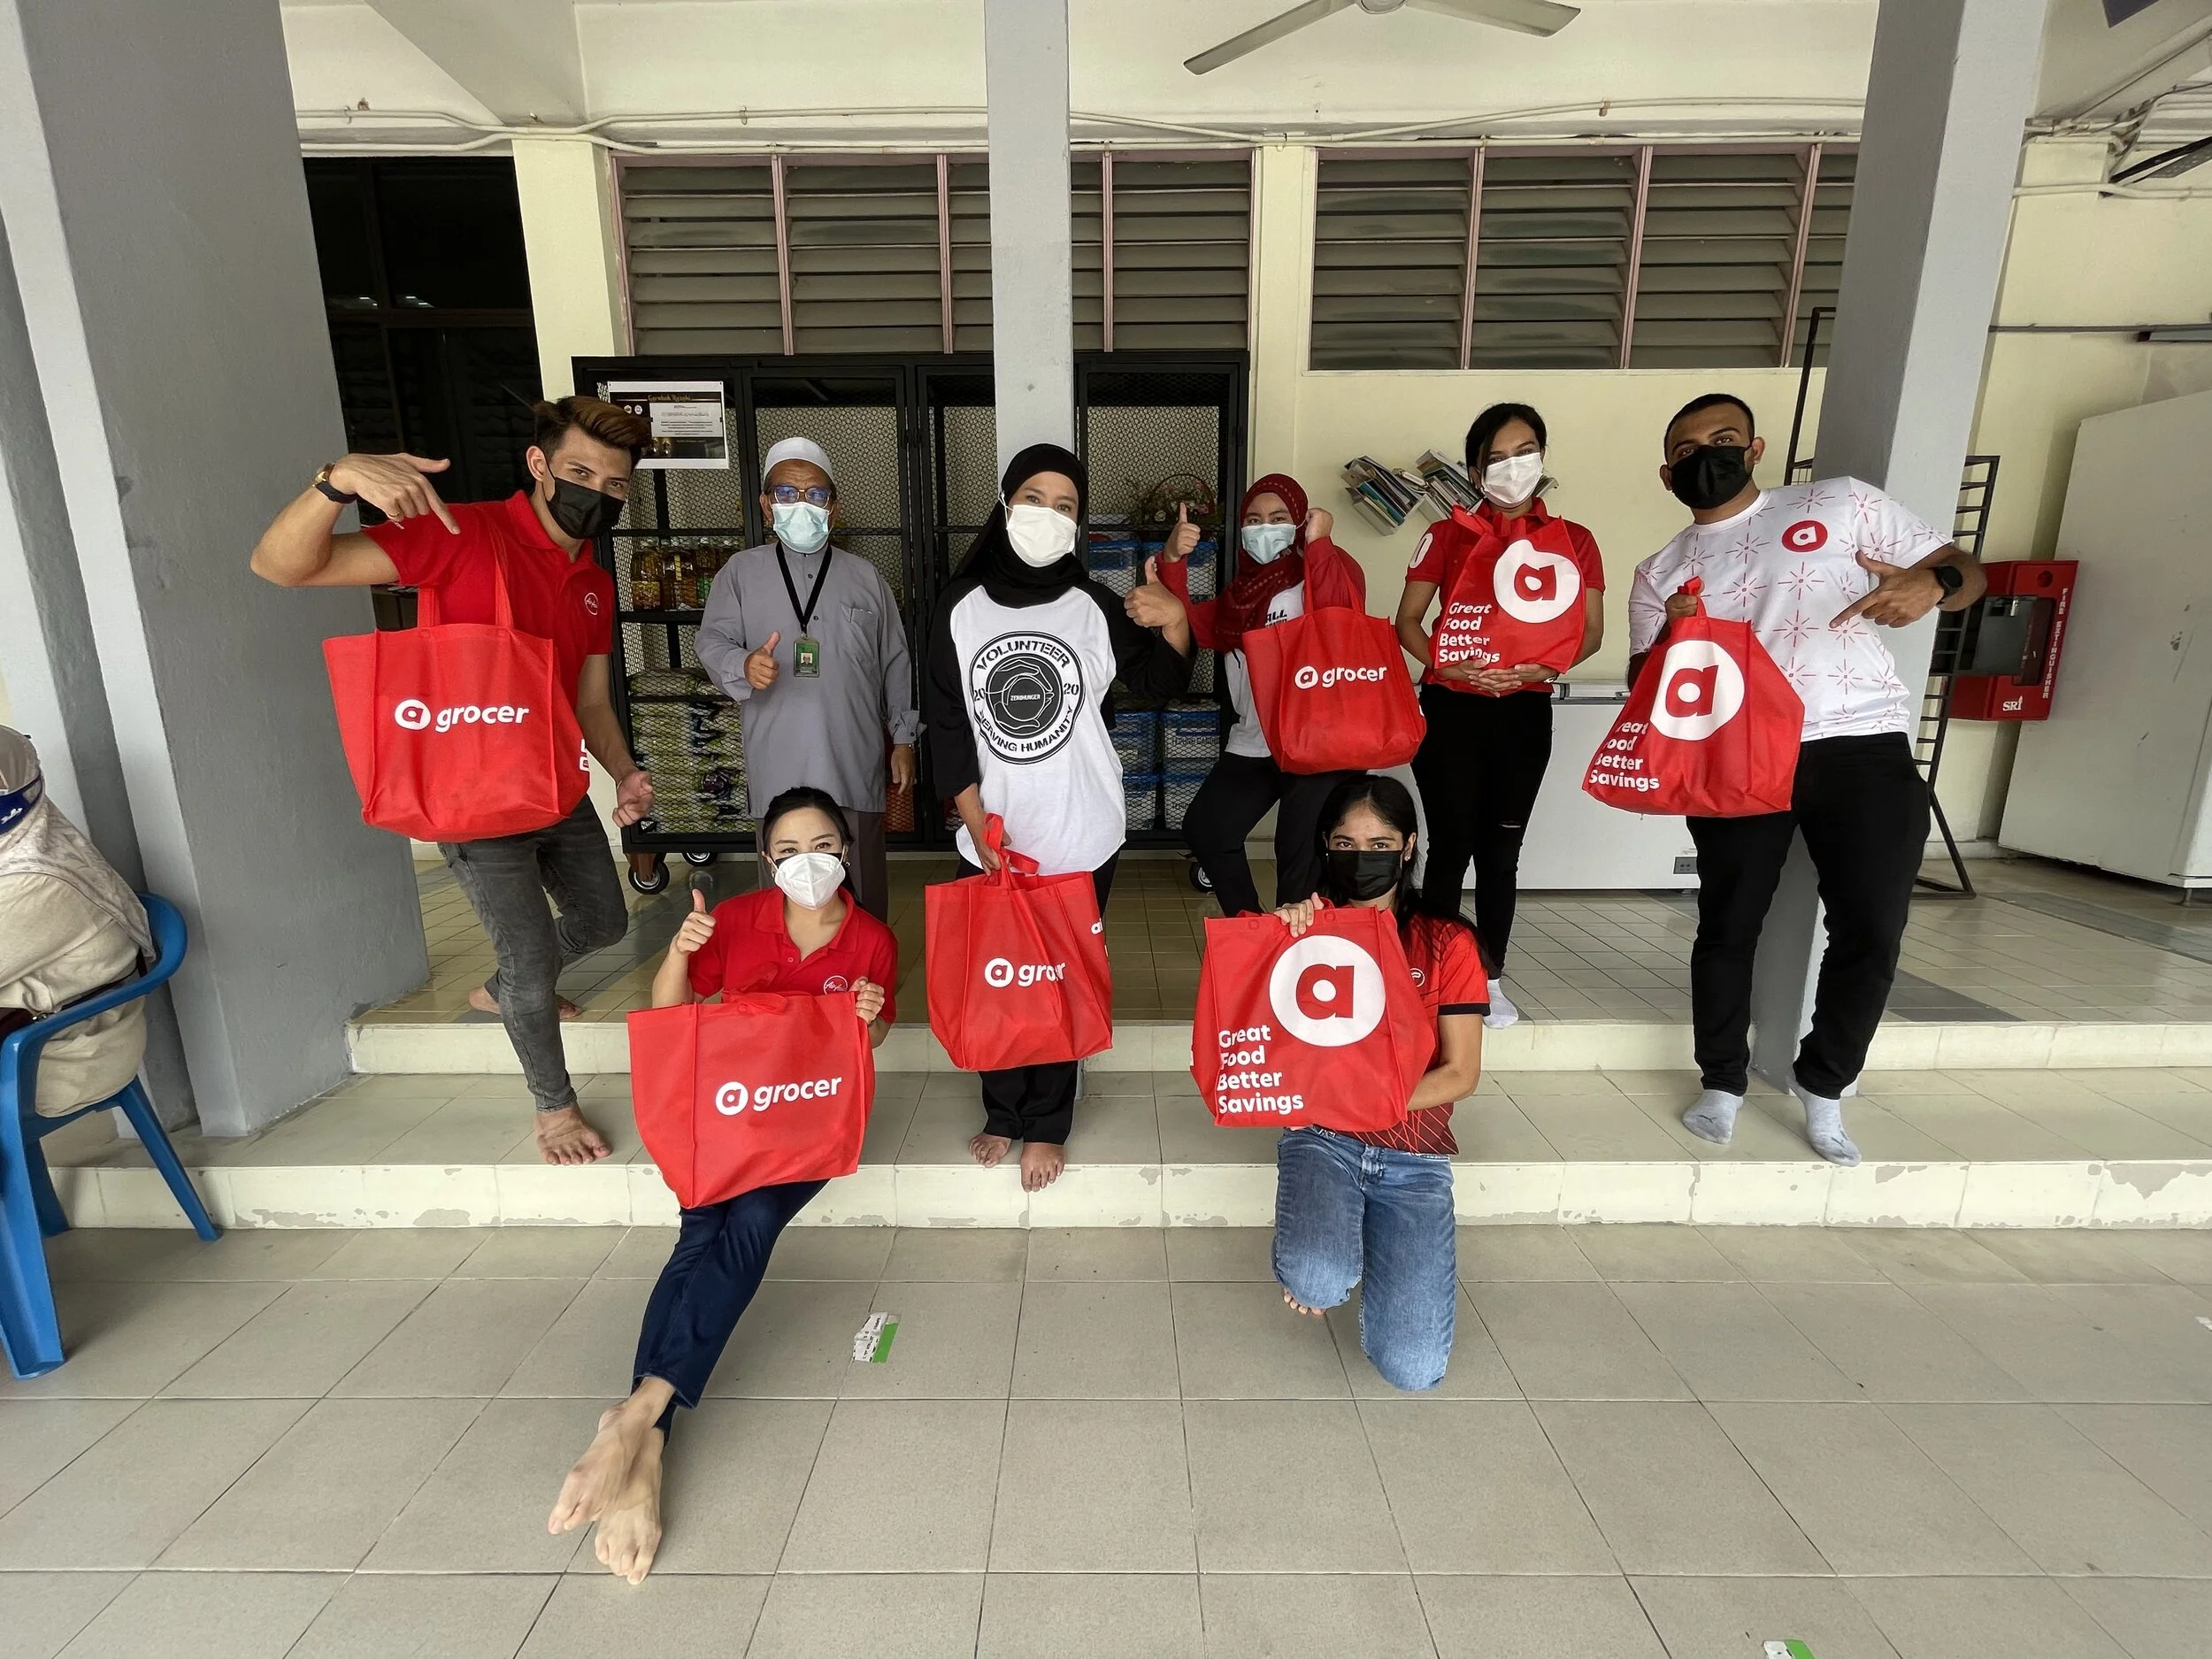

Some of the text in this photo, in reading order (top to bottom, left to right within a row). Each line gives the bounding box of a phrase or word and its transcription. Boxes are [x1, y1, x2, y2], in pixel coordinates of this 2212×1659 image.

[1449, 602, 1493, 615] Great
[1443, 616, 1482, 630] Food
[1439, 633, 1491, 647] Better
[2042, 588, 2070, 699] FIRE EXTINGUISHER
[976, 640, 1071, 671] VOLUNTEER
[1439, 646, 1501, 664] Savings
[1322, 666, 1387, 688] grocer
[972, 682, 1079, 702] 20 20
[2002, 695, 2023, 710] SRI
[434, 705, 529, 733] grocer
[1020, 704, 1073, 752] HUMANITY
[1602, 735, 1638, 751] ood
[1588, 769, 1660, 792] Savings
[1218, 1025, 1271, 1048] Great
[1220, 1044, 1266, 1071] Food
[1217, 1071, 1283, 1092] Better
[753, 1077, 842, 1112] grocer
[1217, 1092, 1304, 1115] Savings
